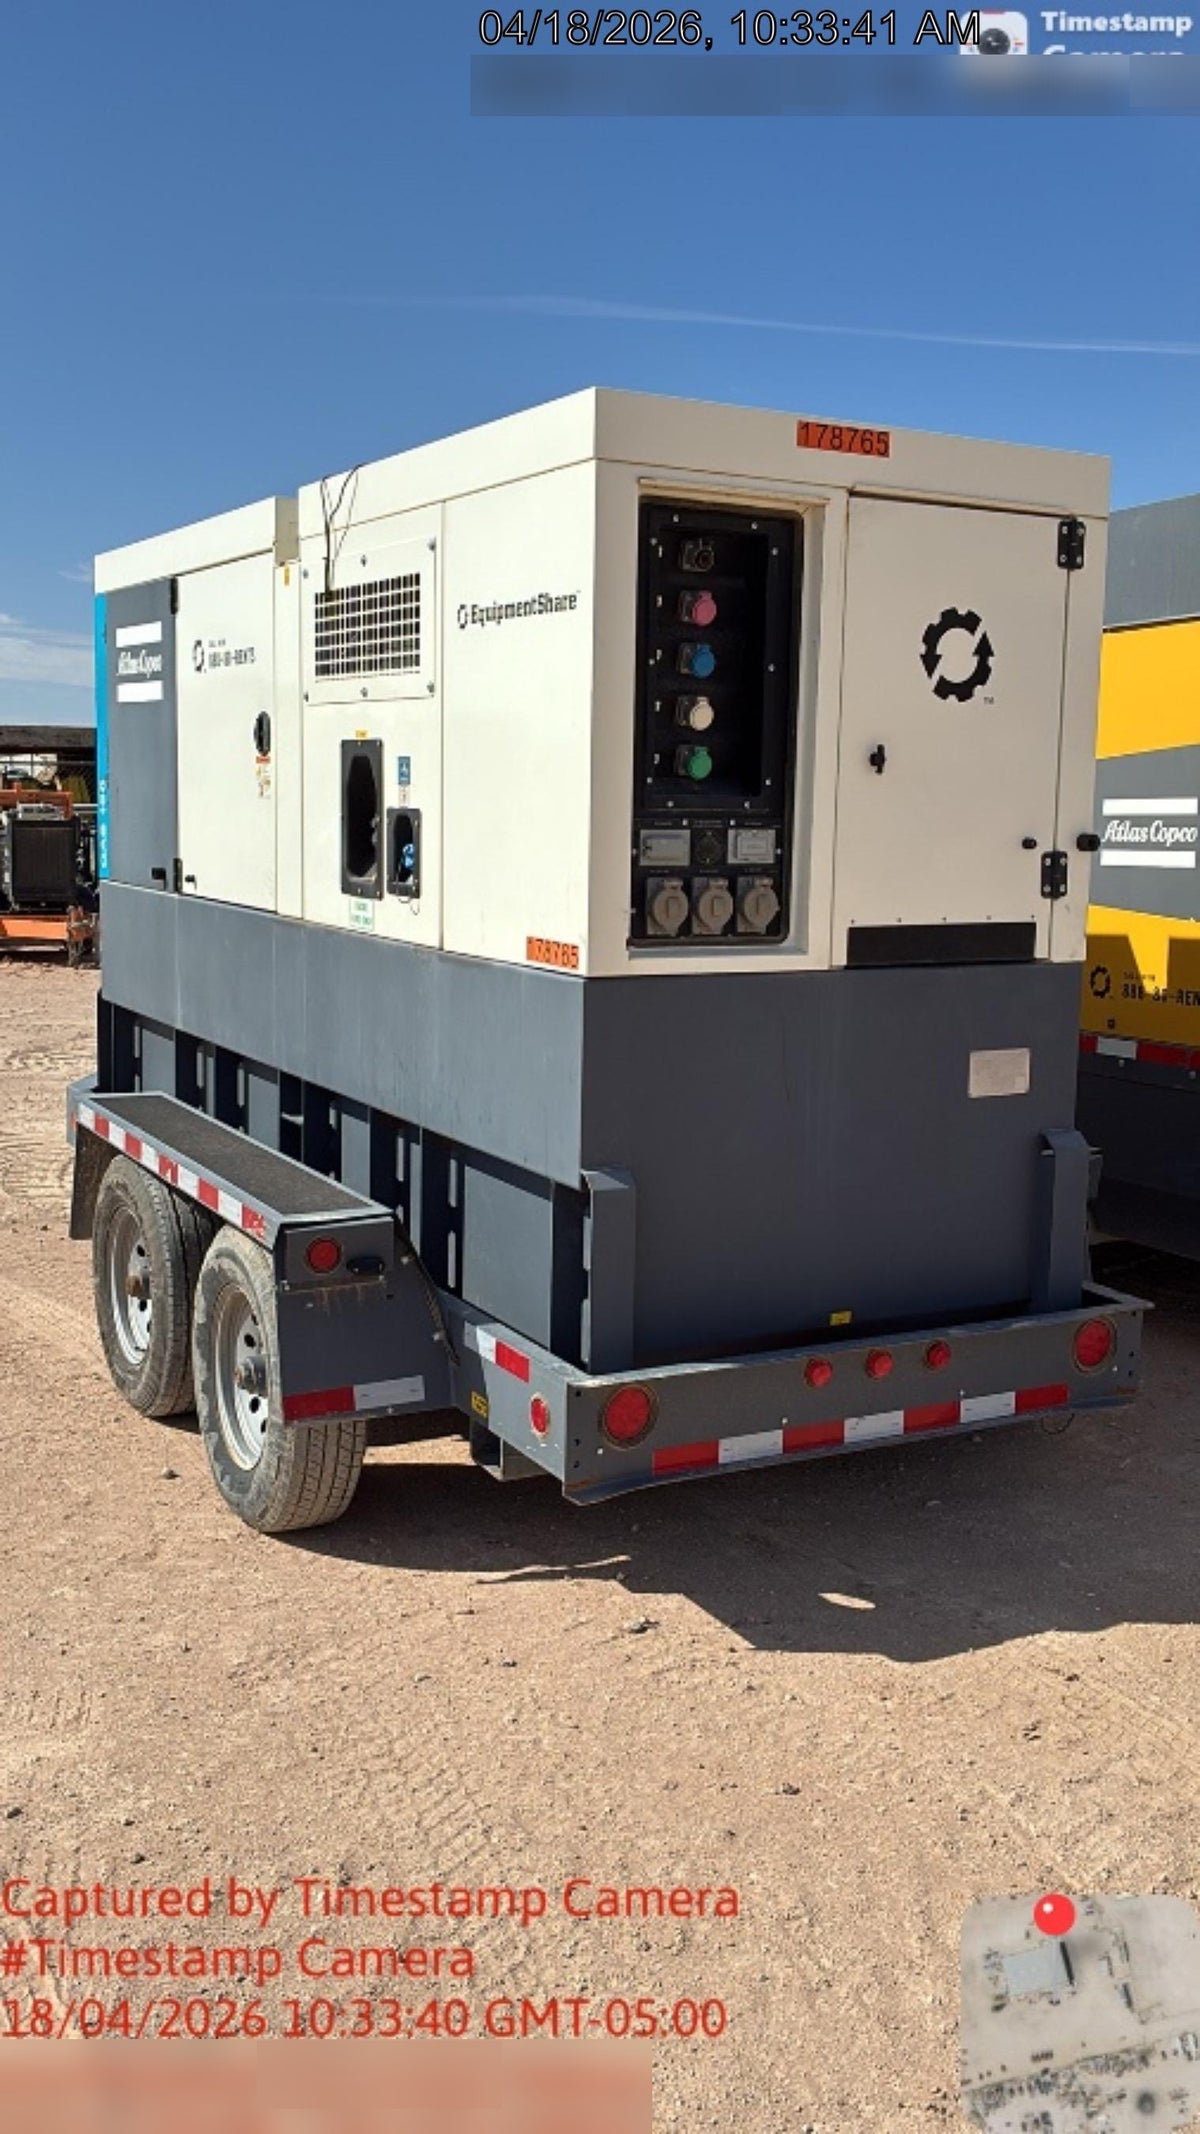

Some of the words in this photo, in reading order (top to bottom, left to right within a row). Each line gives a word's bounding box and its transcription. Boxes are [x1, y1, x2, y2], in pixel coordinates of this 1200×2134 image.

[799, 421, 890, 457] 178765
[471, 592, 577, 627] EquipmentShare
[1100, 819, 1149, 843] Atlas
[1149, 819, 1199, 848] Copco
